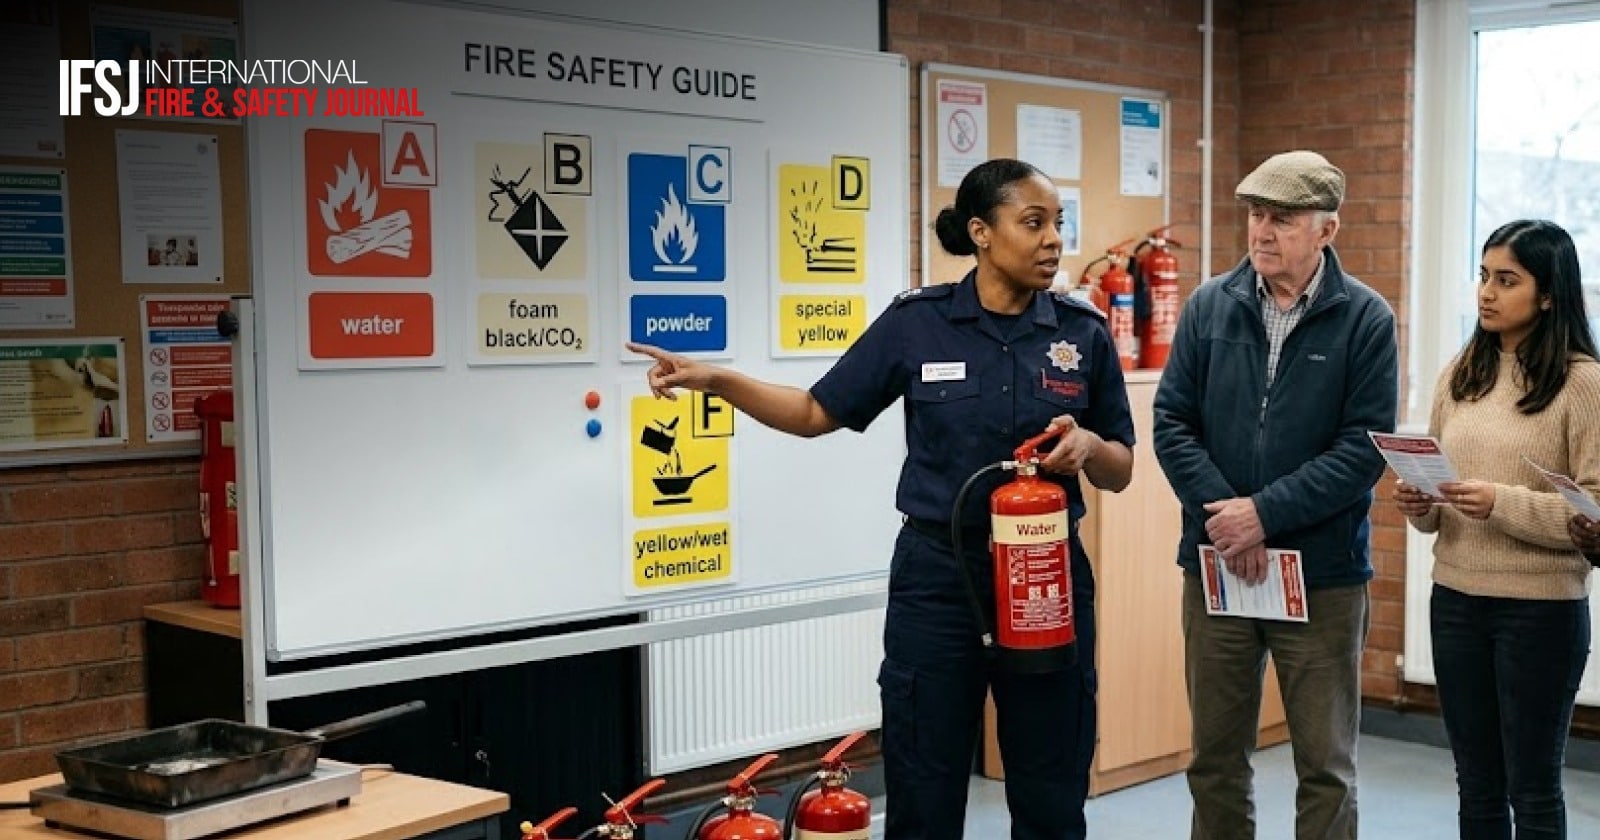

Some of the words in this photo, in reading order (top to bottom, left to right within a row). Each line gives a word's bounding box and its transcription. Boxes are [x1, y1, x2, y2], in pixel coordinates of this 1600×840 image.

[464, 42, 535, 78] FIRE
[547, 51, 664, 91] SAFETY
[672, 66, 757, 100] GUIDE
[391, 131, 430, 177] A
[552, 143, 583, 185] B
[695, 153, 723, 195] C
[838, 164, 863, 201] D
[509, 299, 559, 319] foam
[795, 299, 852, 322] special
[341, 315, 404, 336] water
[646, 313, 712, 336] powder
[798, 323, 848, 344] yellow
[702, 391, 722, 429] F
[635, 528, 728, 559] yellow/wet
[1016, 522, 1057, 537] Water
[644, 554, 721, 580] chemical
